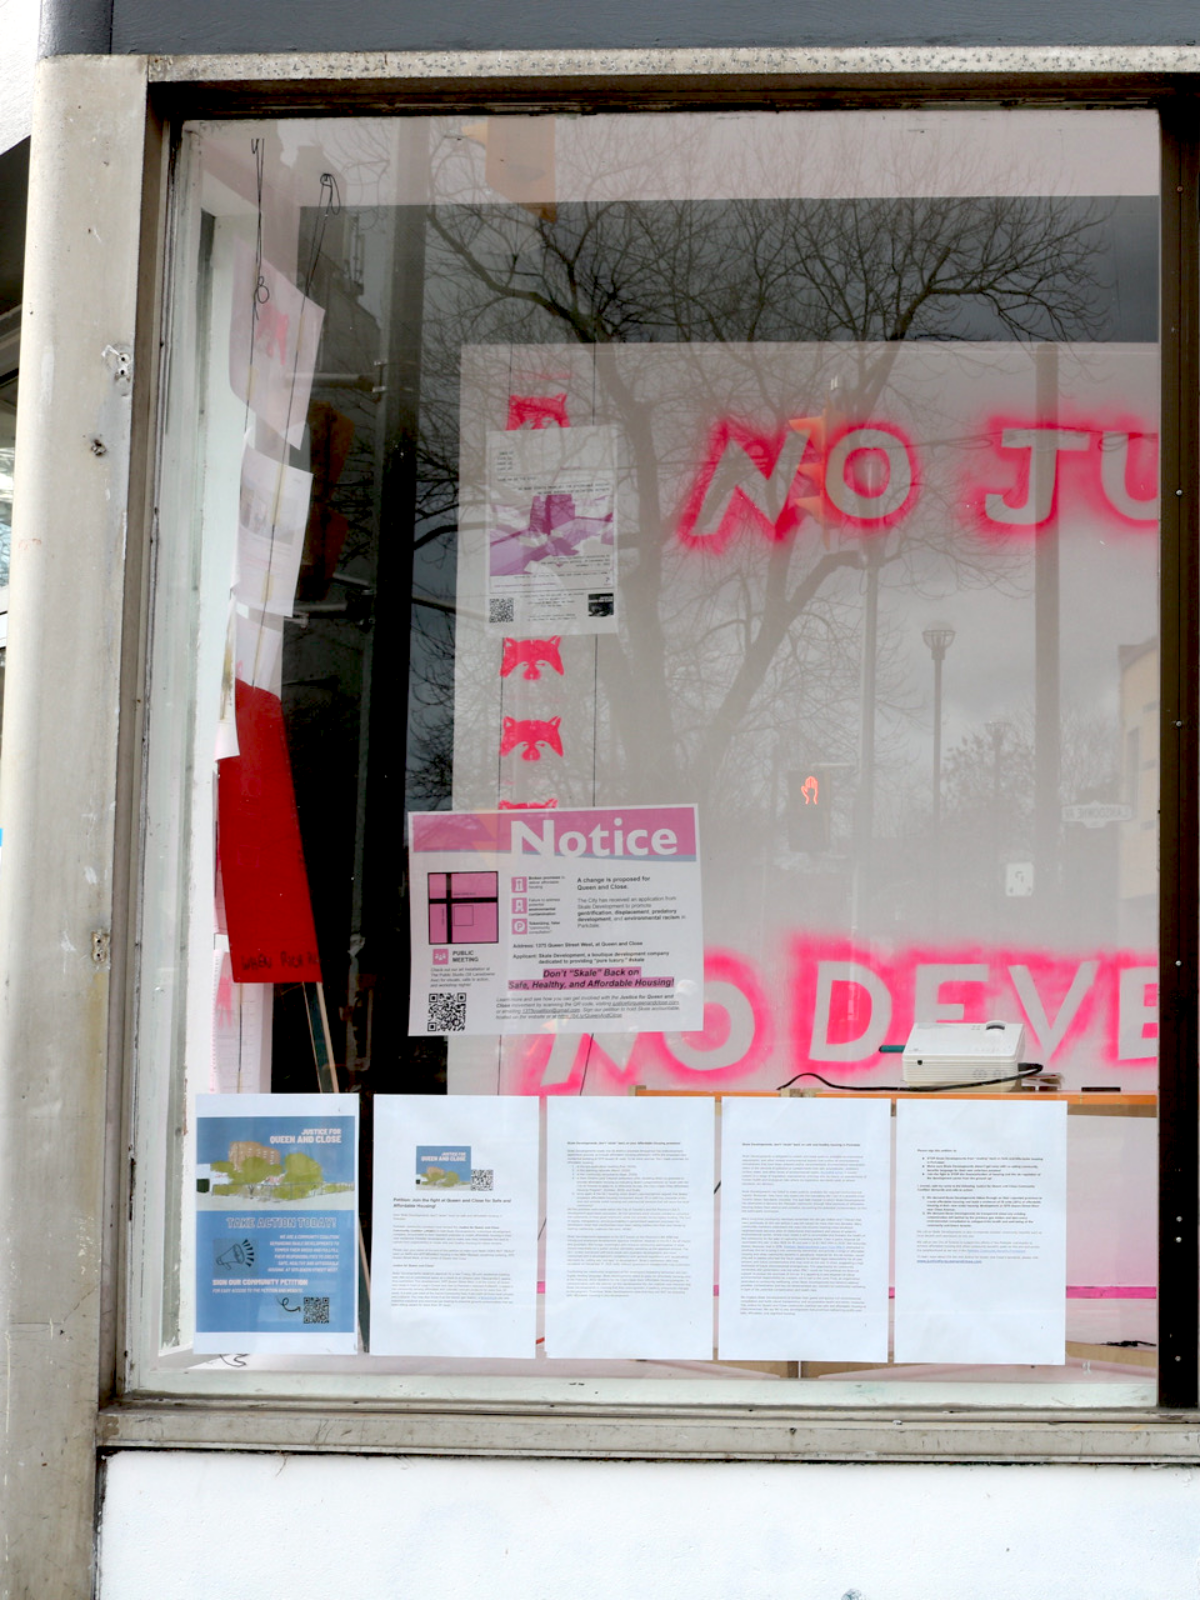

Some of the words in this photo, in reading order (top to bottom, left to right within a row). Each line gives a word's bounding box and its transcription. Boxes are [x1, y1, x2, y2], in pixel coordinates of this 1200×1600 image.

[685, 424, 914, 538] NO
[510, 817, 677, 858] Notice
[543, 969, 567, 978] Don't
[569, 968, 602, 978] "Skale"
[604, 968, 626, 976] Back
[508, 981, 529, 990] Safe,
[532, 981, 567, 990] Healthy,
[569, 980, 585, 988] and
[587, 979, 633, 988] Affordable
[634, 978, 674, 988] Housing!
[301, 1128, 328, 1136] JUSTICE
[329, 1128, 342, 1136] FOR
[270, 1135, 296, 1145] QUEEN
[297, 1135, 314, 1144] AND
[315, 1135, 342, 1144] CLOSE
[226, 1217, 255, 1228] TAKE
[257, 1217, 296, 1228] ACTION
[298, 1216, 337, 1228] TODAY!
